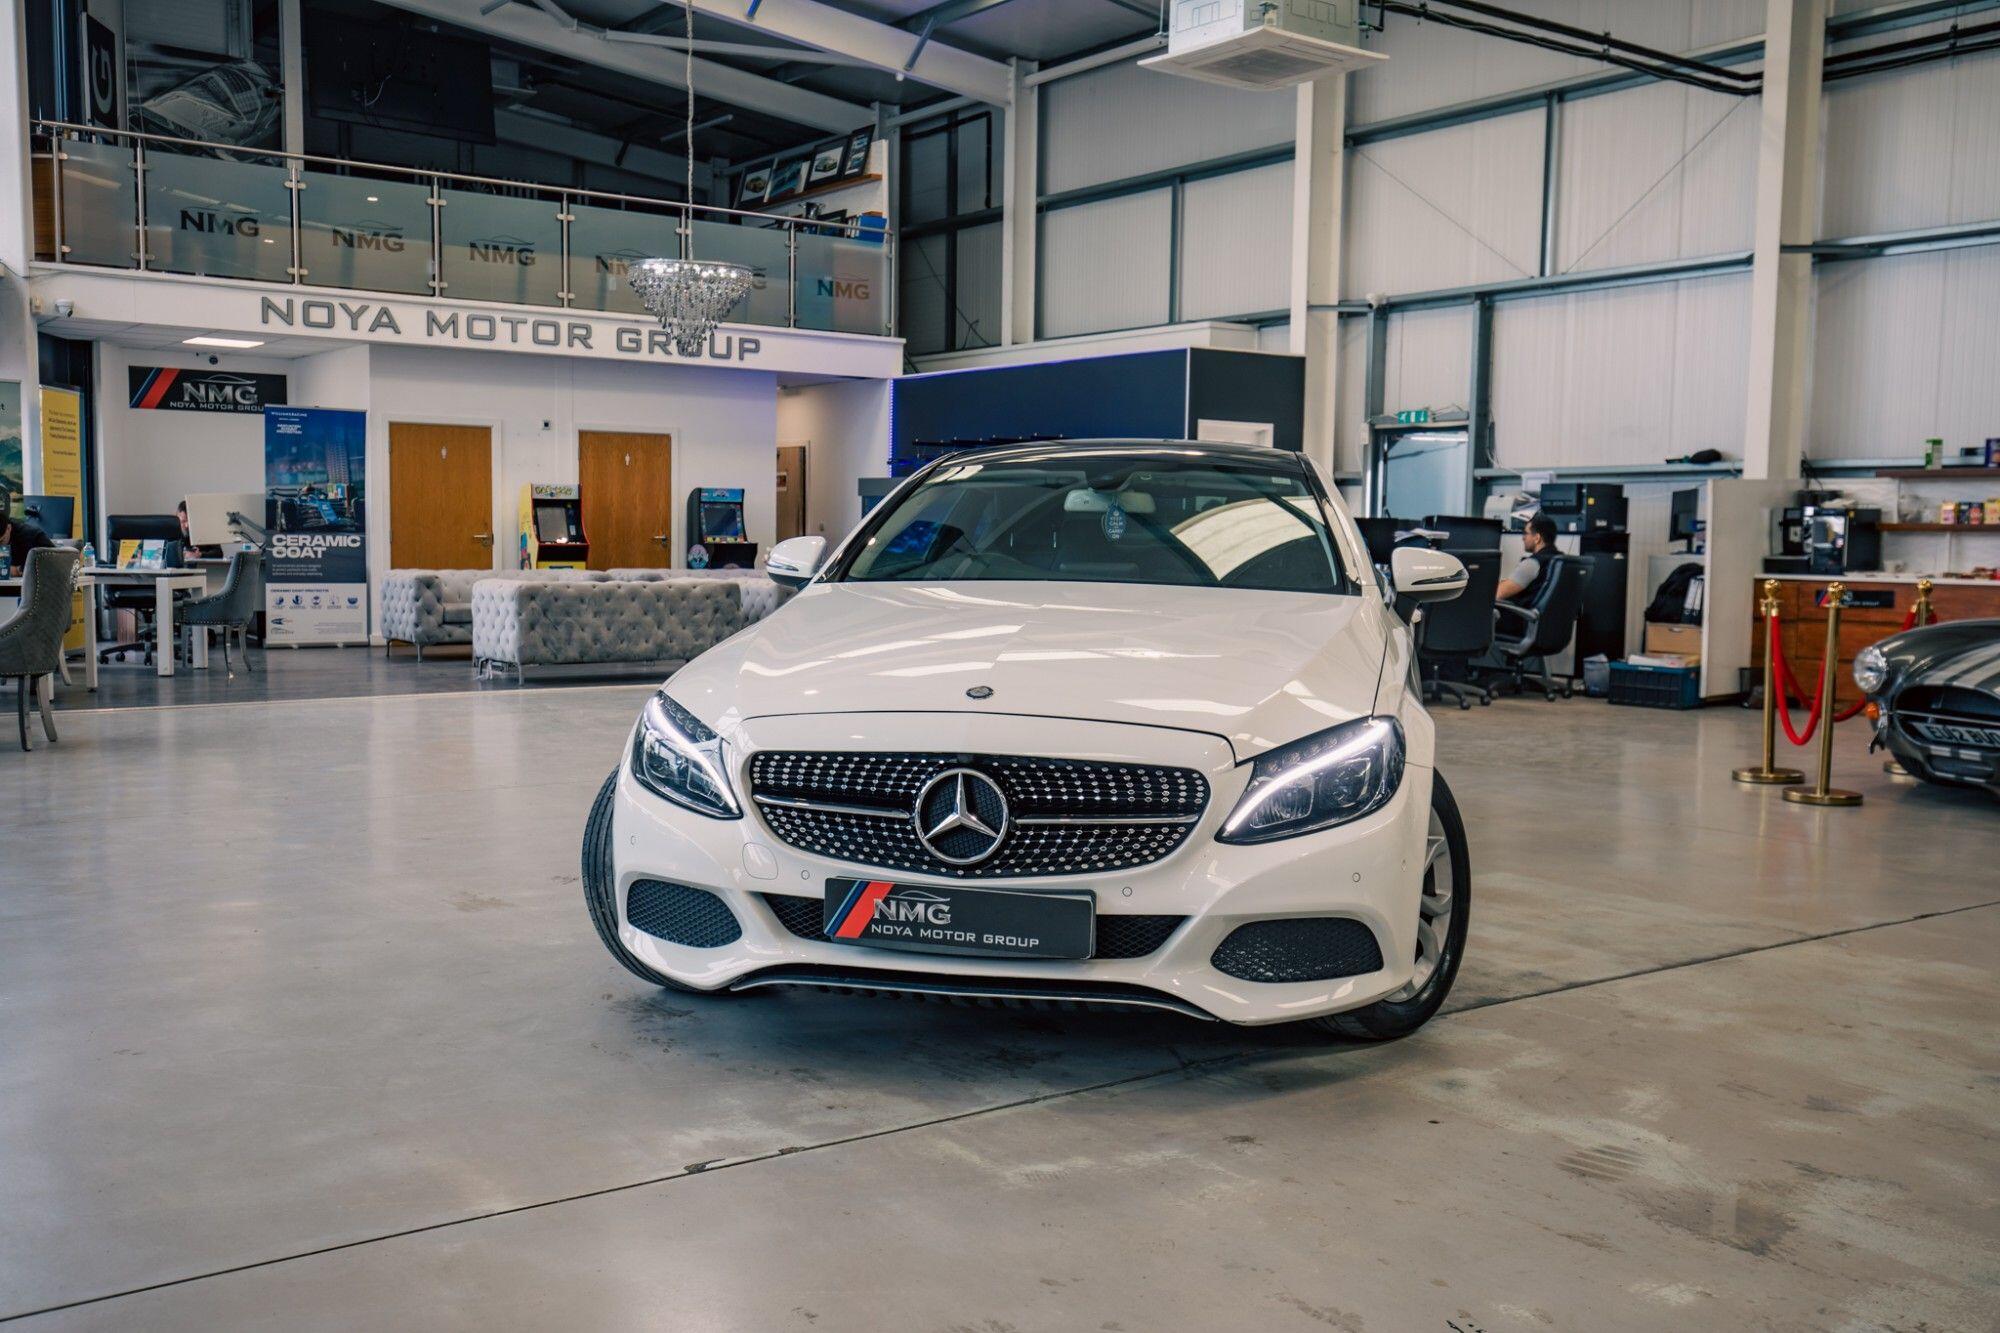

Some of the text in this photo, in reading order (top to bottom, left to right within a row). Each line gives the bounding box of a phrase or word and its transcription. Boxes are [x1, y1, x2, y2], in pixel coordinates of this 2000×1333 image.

[180, 209, 260, 237] NMG
[332, 228, 405, 252] NMG
[469, 242, 536, 266] NMG
[816, 278, 870, 300] NMG
[261, 296, 402, 335] NOYA
[426, 309, 594, 350] MOTOR
[183, 382, 258, 405] NMG
[170, 401, 196, 409] NOYA
[200, 403, 233, 411] MOTOR
[272, 534, 361, 548] CERAMIC
[272, 546, 327, 559] COAT
[873, 897, 951, 925] NMG
[871, 924, 1039, 948] NOYA MOTOR GROUP
